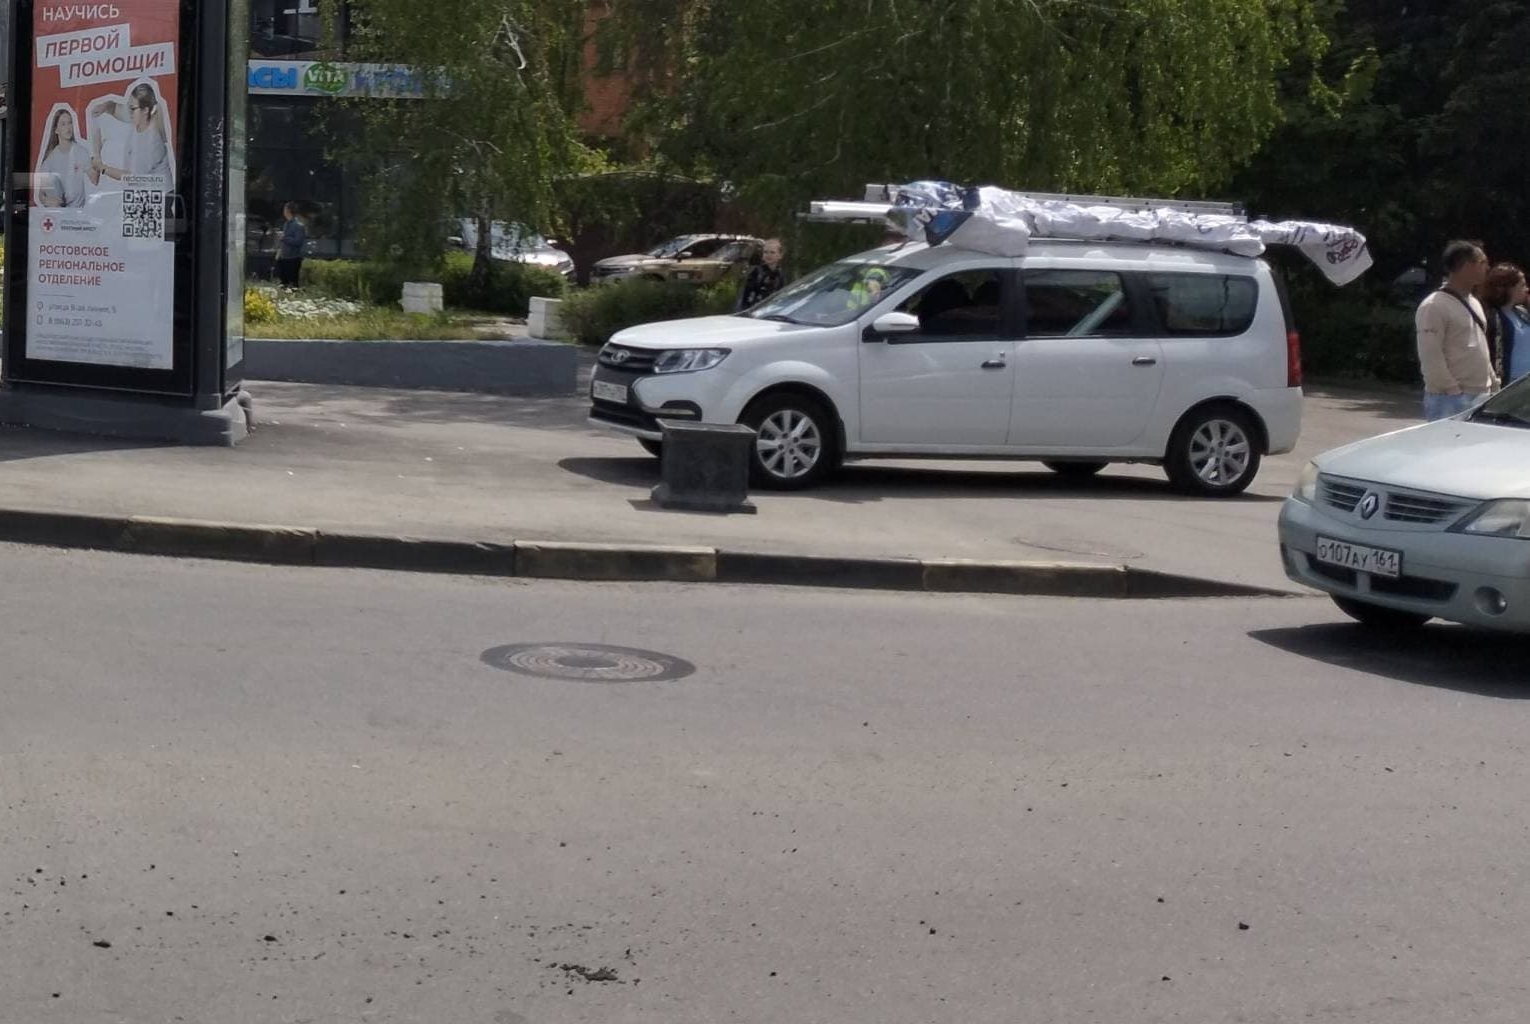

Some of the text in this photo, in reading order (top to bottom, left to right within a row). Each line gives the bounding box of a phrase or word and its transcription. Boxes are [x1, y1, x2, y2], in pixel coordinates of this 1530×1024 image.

[42, 4, 120, 22] НАУЧИСЬ
[45, 28, 120, 59] ПЕРВОЙ
[69, 51, 166, 80] ПОМОЩИ!
[248, 66, 298, 88] СЫ
[39, 244, 110, 257] РОСТОВСКОЕ
[38, 259, 126, 273] РЕГИОНАЛЬНОЕ
[38, 273, 102, 287] ОТДЕЛЕНИЕ
